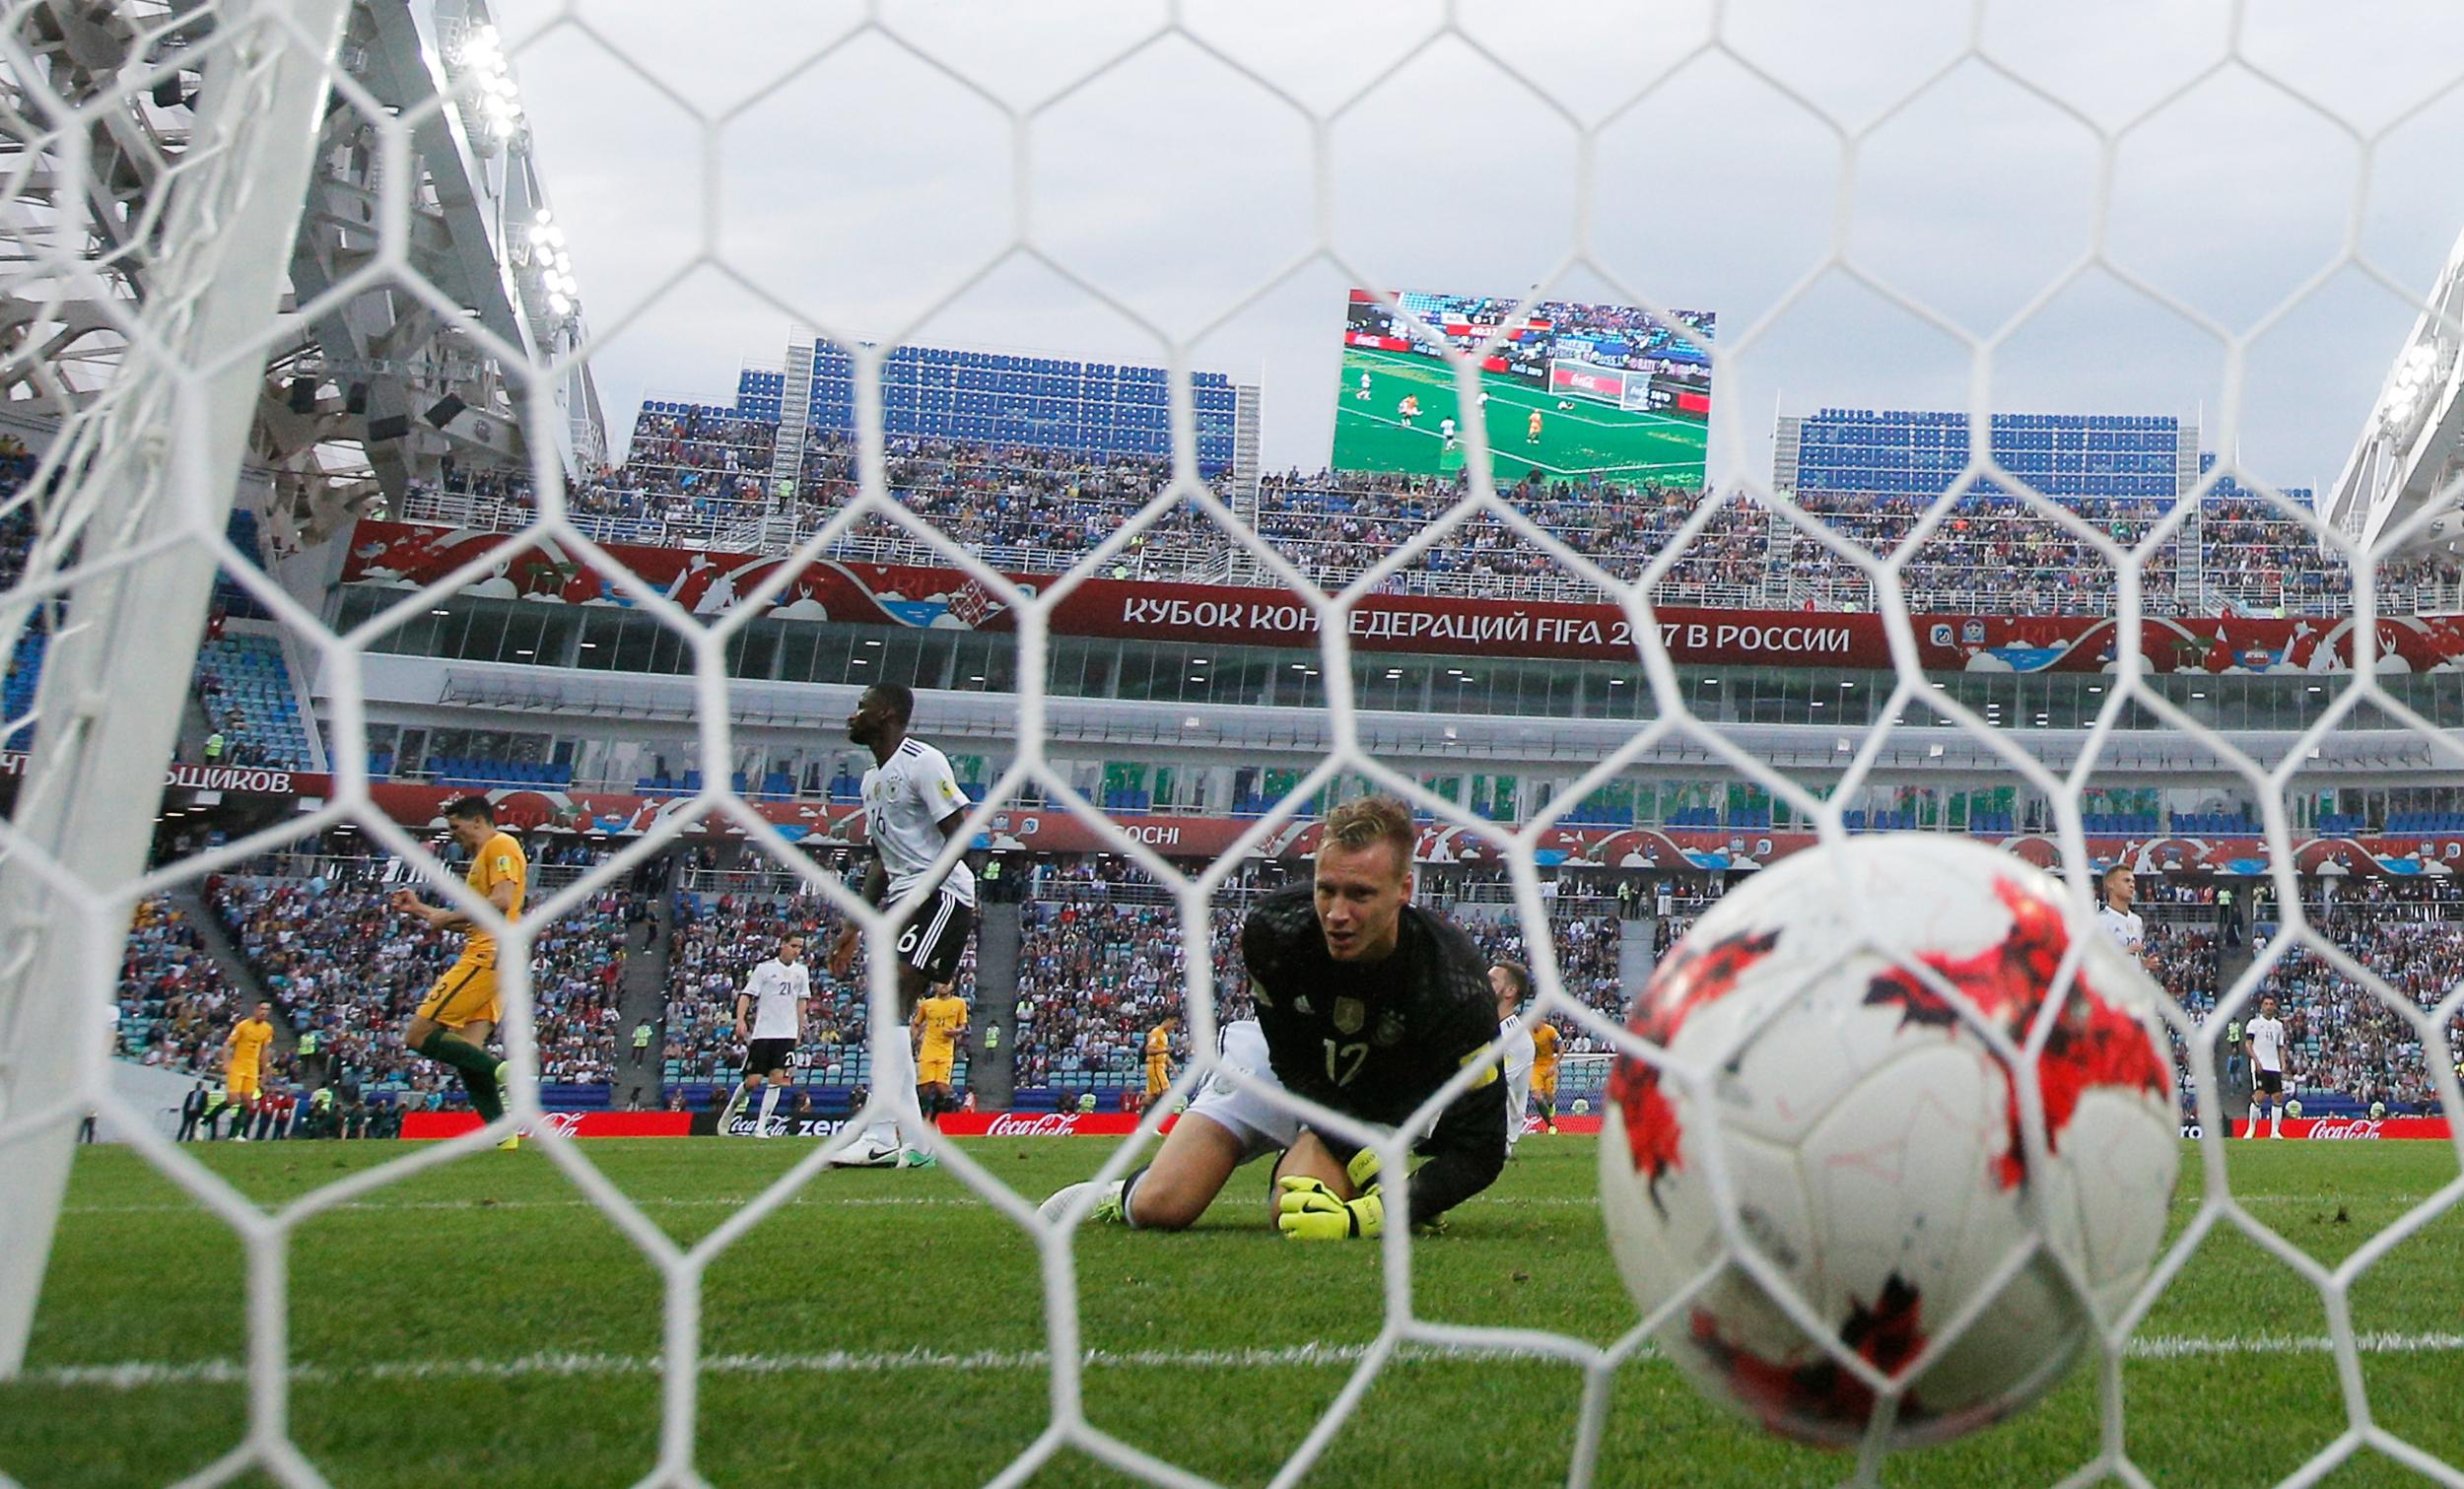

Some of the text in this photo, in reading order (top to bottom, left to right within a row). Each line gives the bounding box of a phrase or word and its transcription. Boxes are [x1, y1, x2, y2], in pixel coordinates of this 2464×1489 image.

[1124, 597, 1244, 629] КУБОК
[1250, 603, 1529, 644] КОНЕДЕРАЦИЙ
[1536, 618, 1603, 644] FIFA
[1686, 624, 1709, 648] В
[1716, 625, 1850, 652] РОССИИ
[871, 808, 886, 836] 16
[780, 981, 791, 996] 21
[987, 1113, 1080, 1136] Coca-Cola
[2307, 1119, 2384, 1139] Coca-Cola
